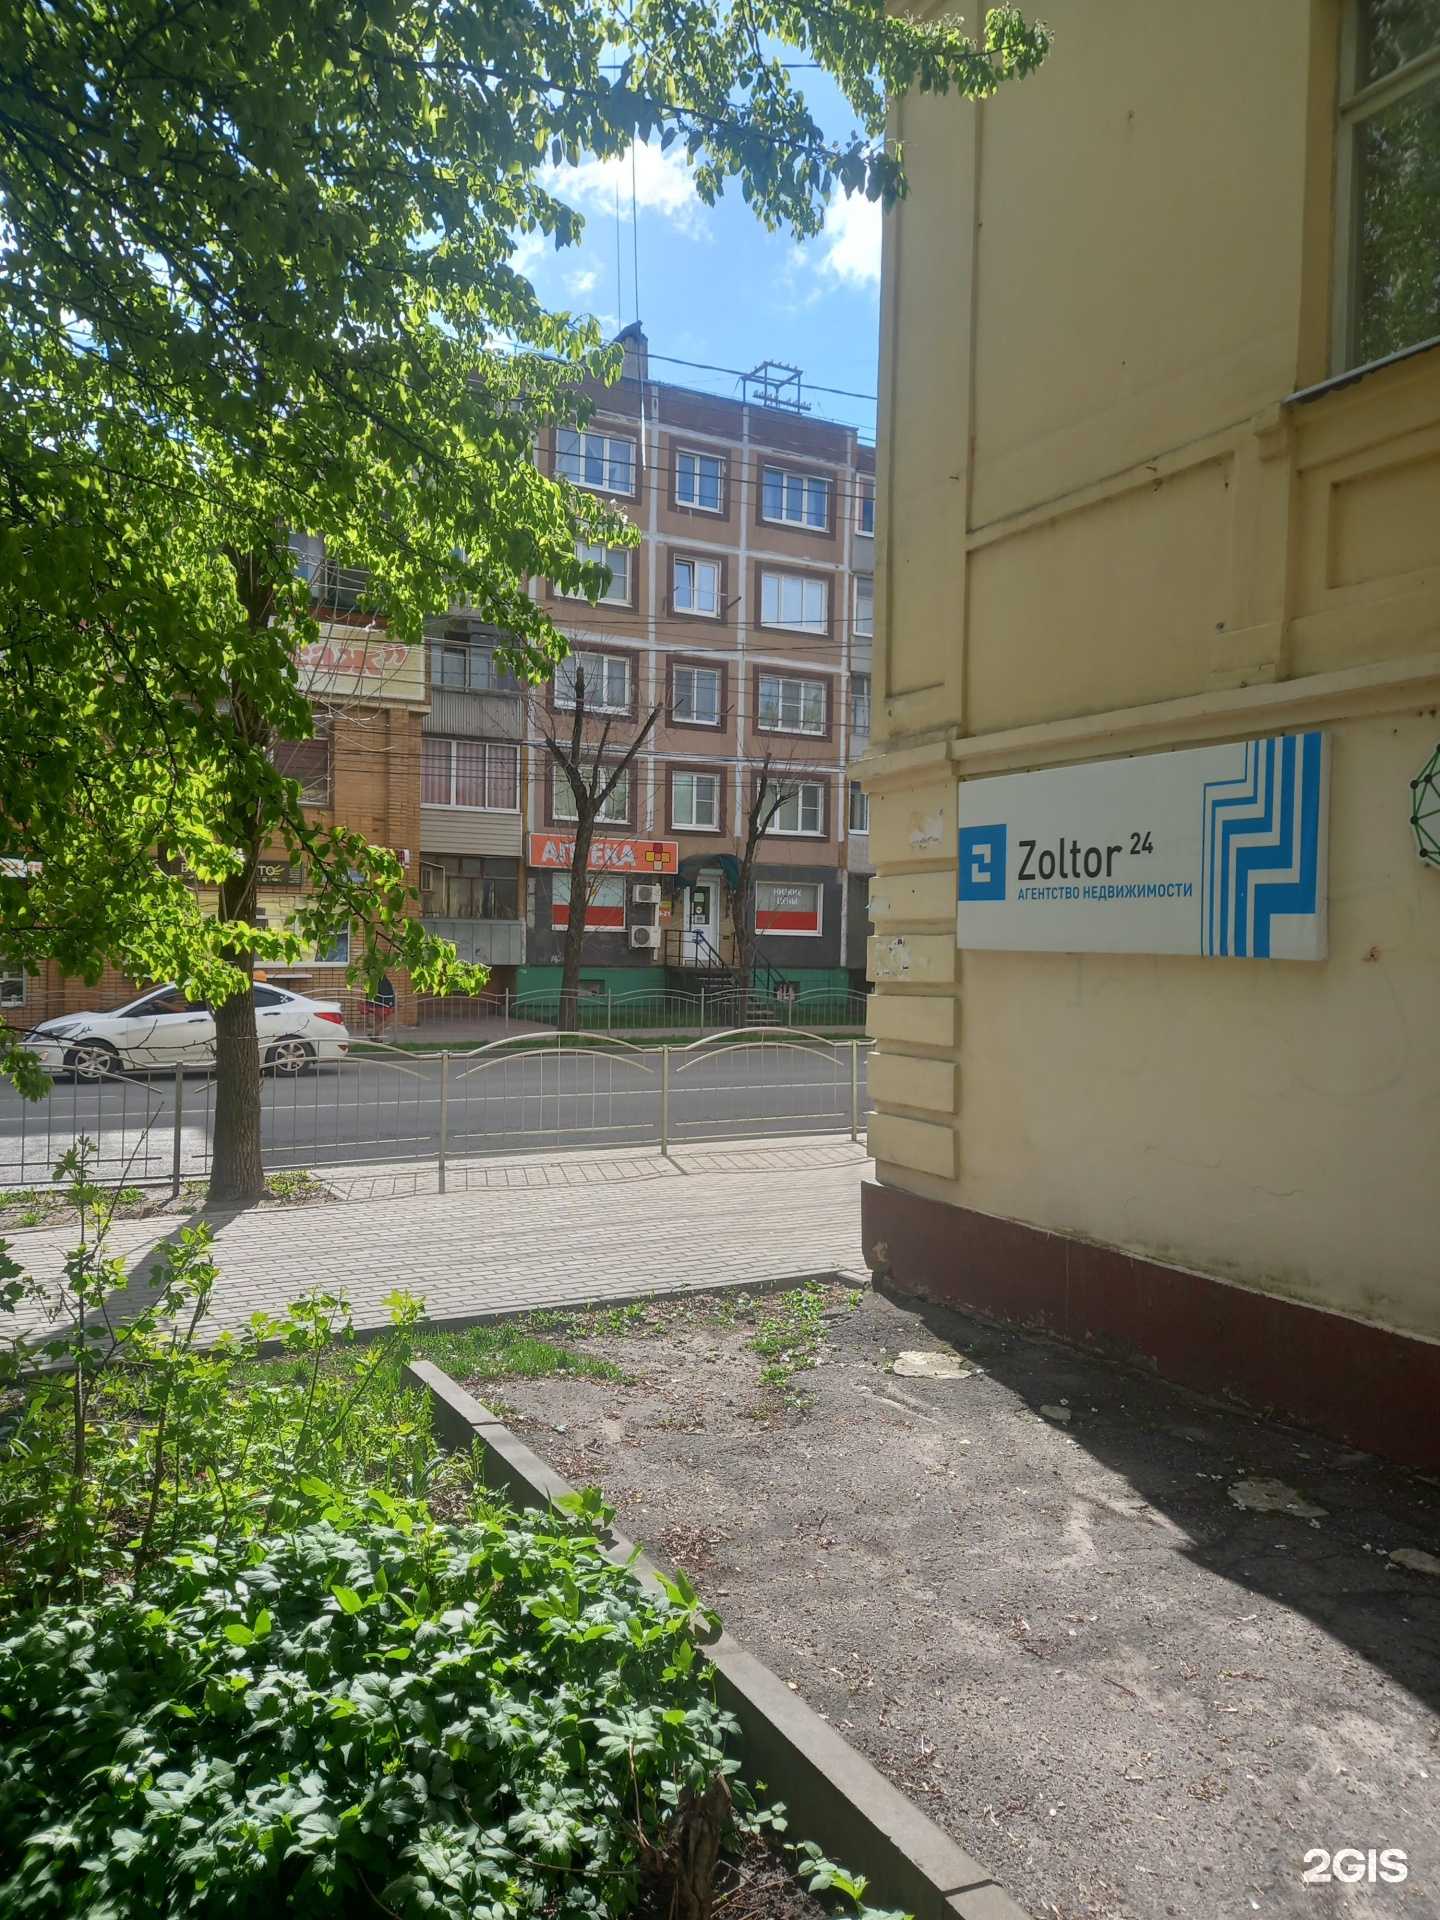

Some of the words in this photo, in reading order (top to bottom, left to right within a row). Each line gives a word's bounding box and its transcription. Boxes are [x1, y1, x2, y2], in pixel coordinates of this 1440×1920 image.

[541, 840, 637, 866] АПЕКА
[1017, 837, 1123, 881] Zoltor
[1129, 831, 1154, 855] 24
[1017, 886, 1080, 901] АГЕНТСТВО
[1083, 883, 1193, 901] НЕДВИЖИМОСТИ
